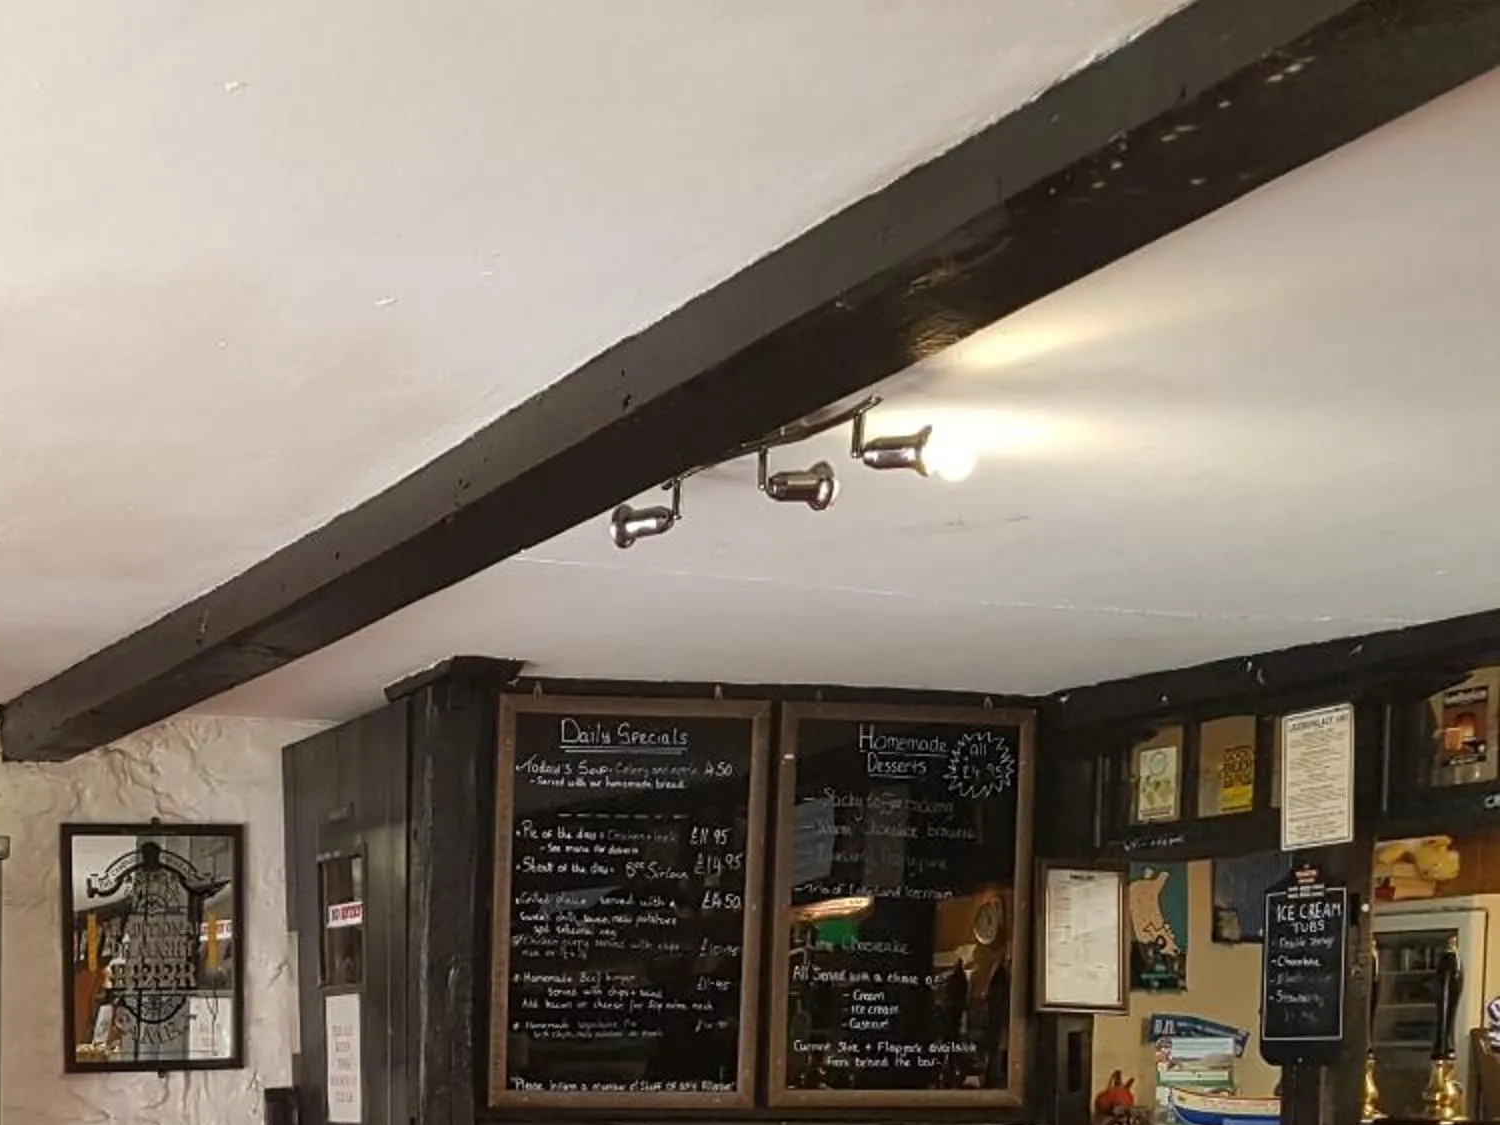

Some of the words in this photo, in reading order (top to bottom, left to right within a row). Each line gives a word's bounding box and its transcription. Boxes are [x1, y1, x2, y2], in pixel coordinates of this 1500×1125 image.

[561, 717, 611, 746] Daily
[617, 722, 689, 747] Specials
[858, 723, 948, 753] Homemade
[867, 752, 928, 776] Desserts
[1277, 904, 1297, 924] ICE
[1299, 901, 1342, 922] CREAM
[1292, 918, 1326, 934] TUBS
